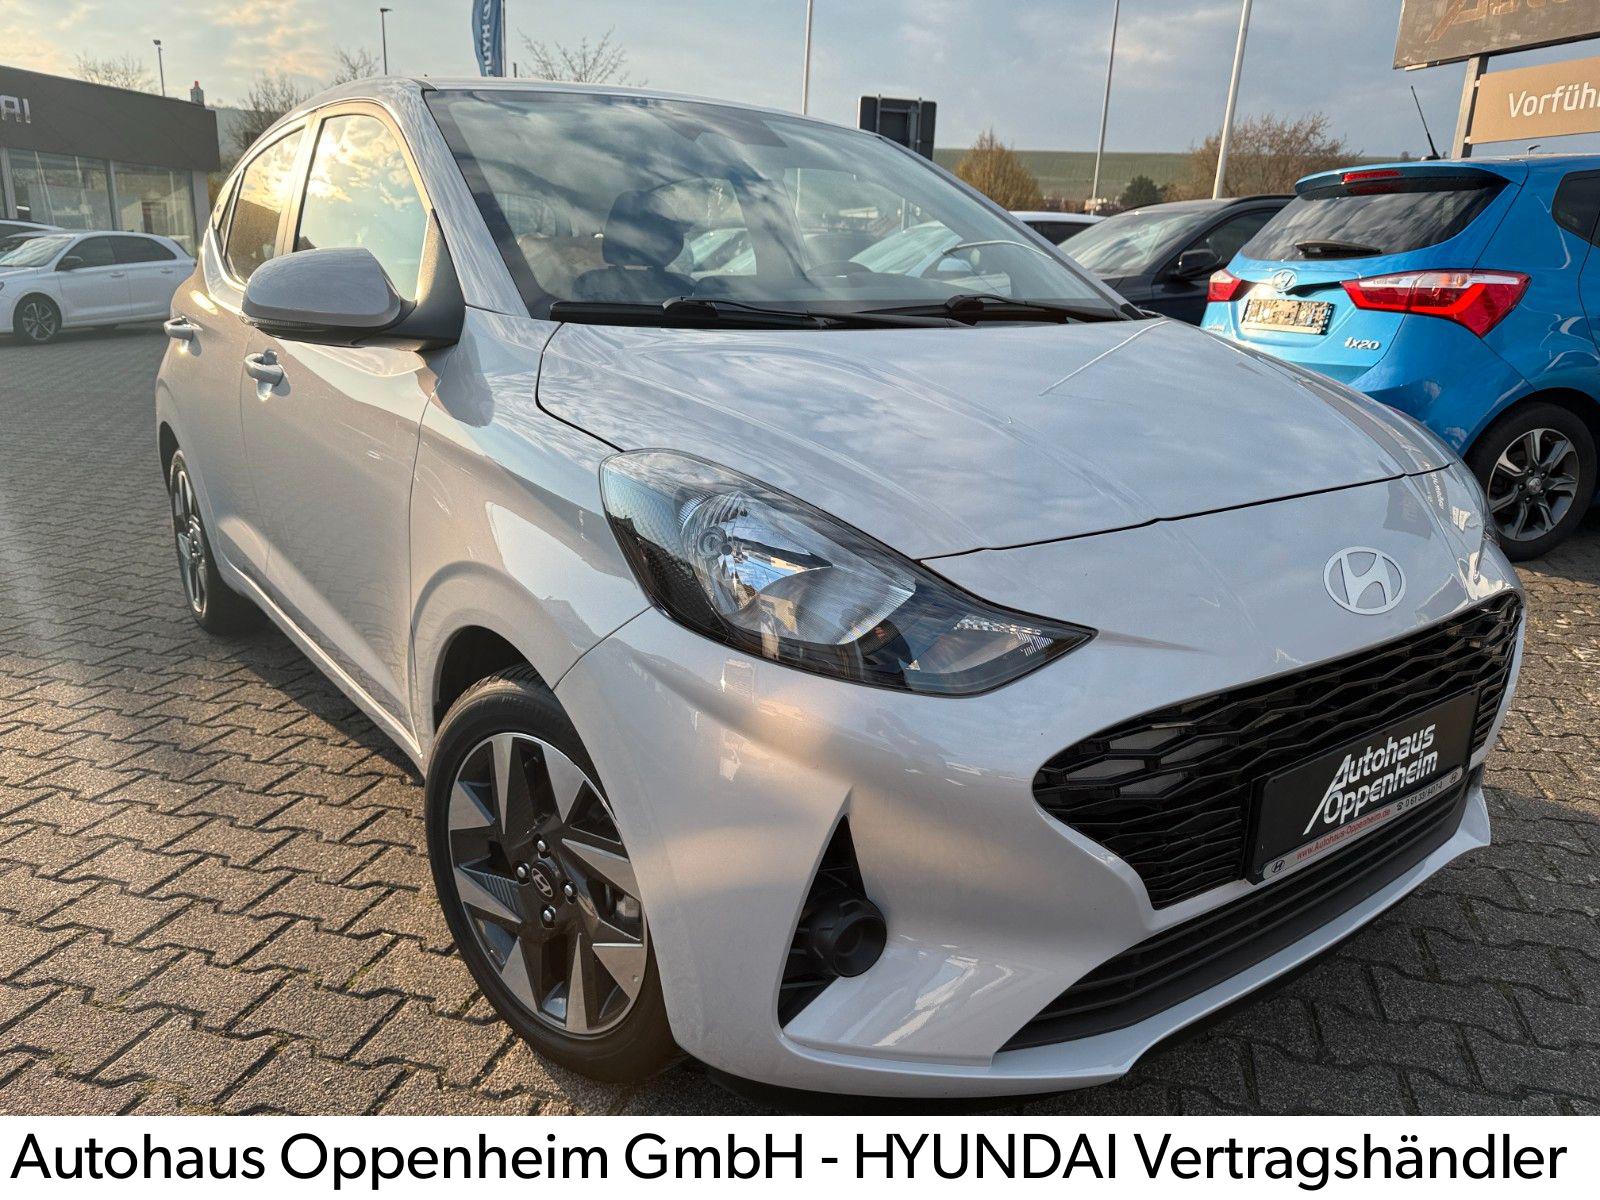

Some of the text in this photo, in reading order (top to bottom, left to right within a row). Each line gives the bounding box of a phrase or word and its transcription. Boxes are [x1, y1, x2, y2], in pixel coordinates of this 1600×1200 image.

[1508, 81, 1600, 118] Vorfüh
[1303, 723, 1437, 836] Autohaus
[1323, 751, 1438, 825] Oppenheim
[1296, 808, 1391, 860] www.Autohaus-Oppenheim.de
